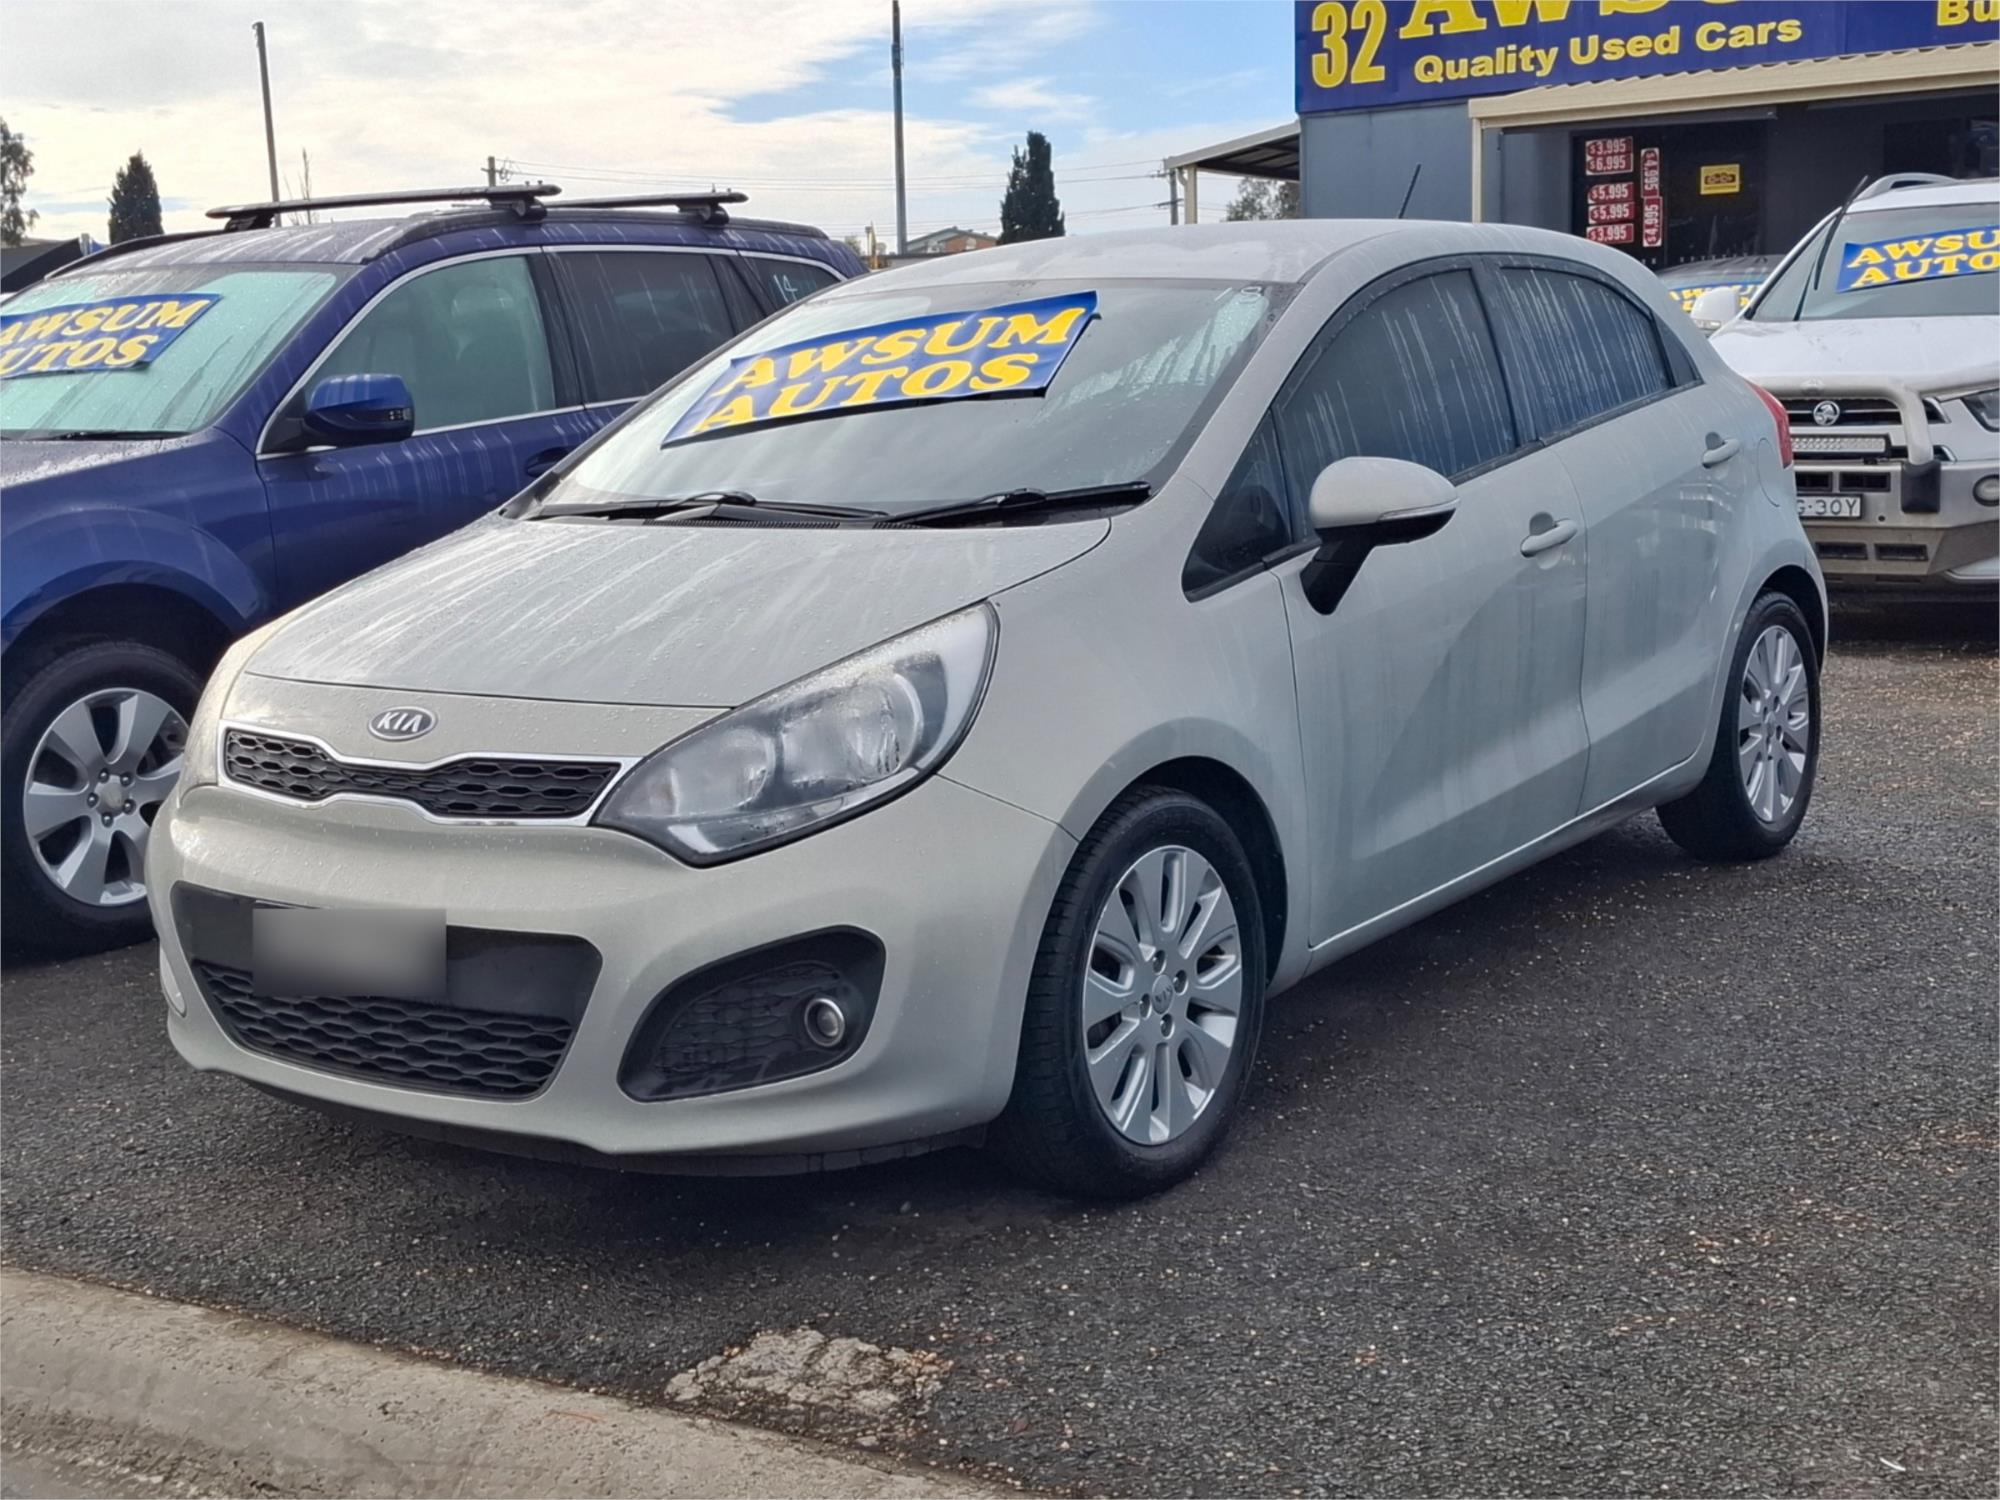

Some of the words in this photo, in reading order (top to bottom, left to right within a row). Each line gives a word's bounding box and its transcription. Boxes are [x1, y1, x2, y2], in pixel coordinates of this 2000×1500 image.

[1311, 1, 1387, 88] 32
[1414, 44, 1559, 84] Quality
[1570, 26, 1680, 65] Used
[1696, 19, 1802, 51] Cars
[1590, 154, 1626, 171] $6,995
[1591, 184, 1629, 201] $5,995
[1592, 203, 1630, 220] $5,995
[1850, 251, 2000, 288] AUTO
[712, 307, 1087, 396] AWSUM
[690, 353, 1039, 434] AUTOS
[376, 711, 423, 733] KIA
